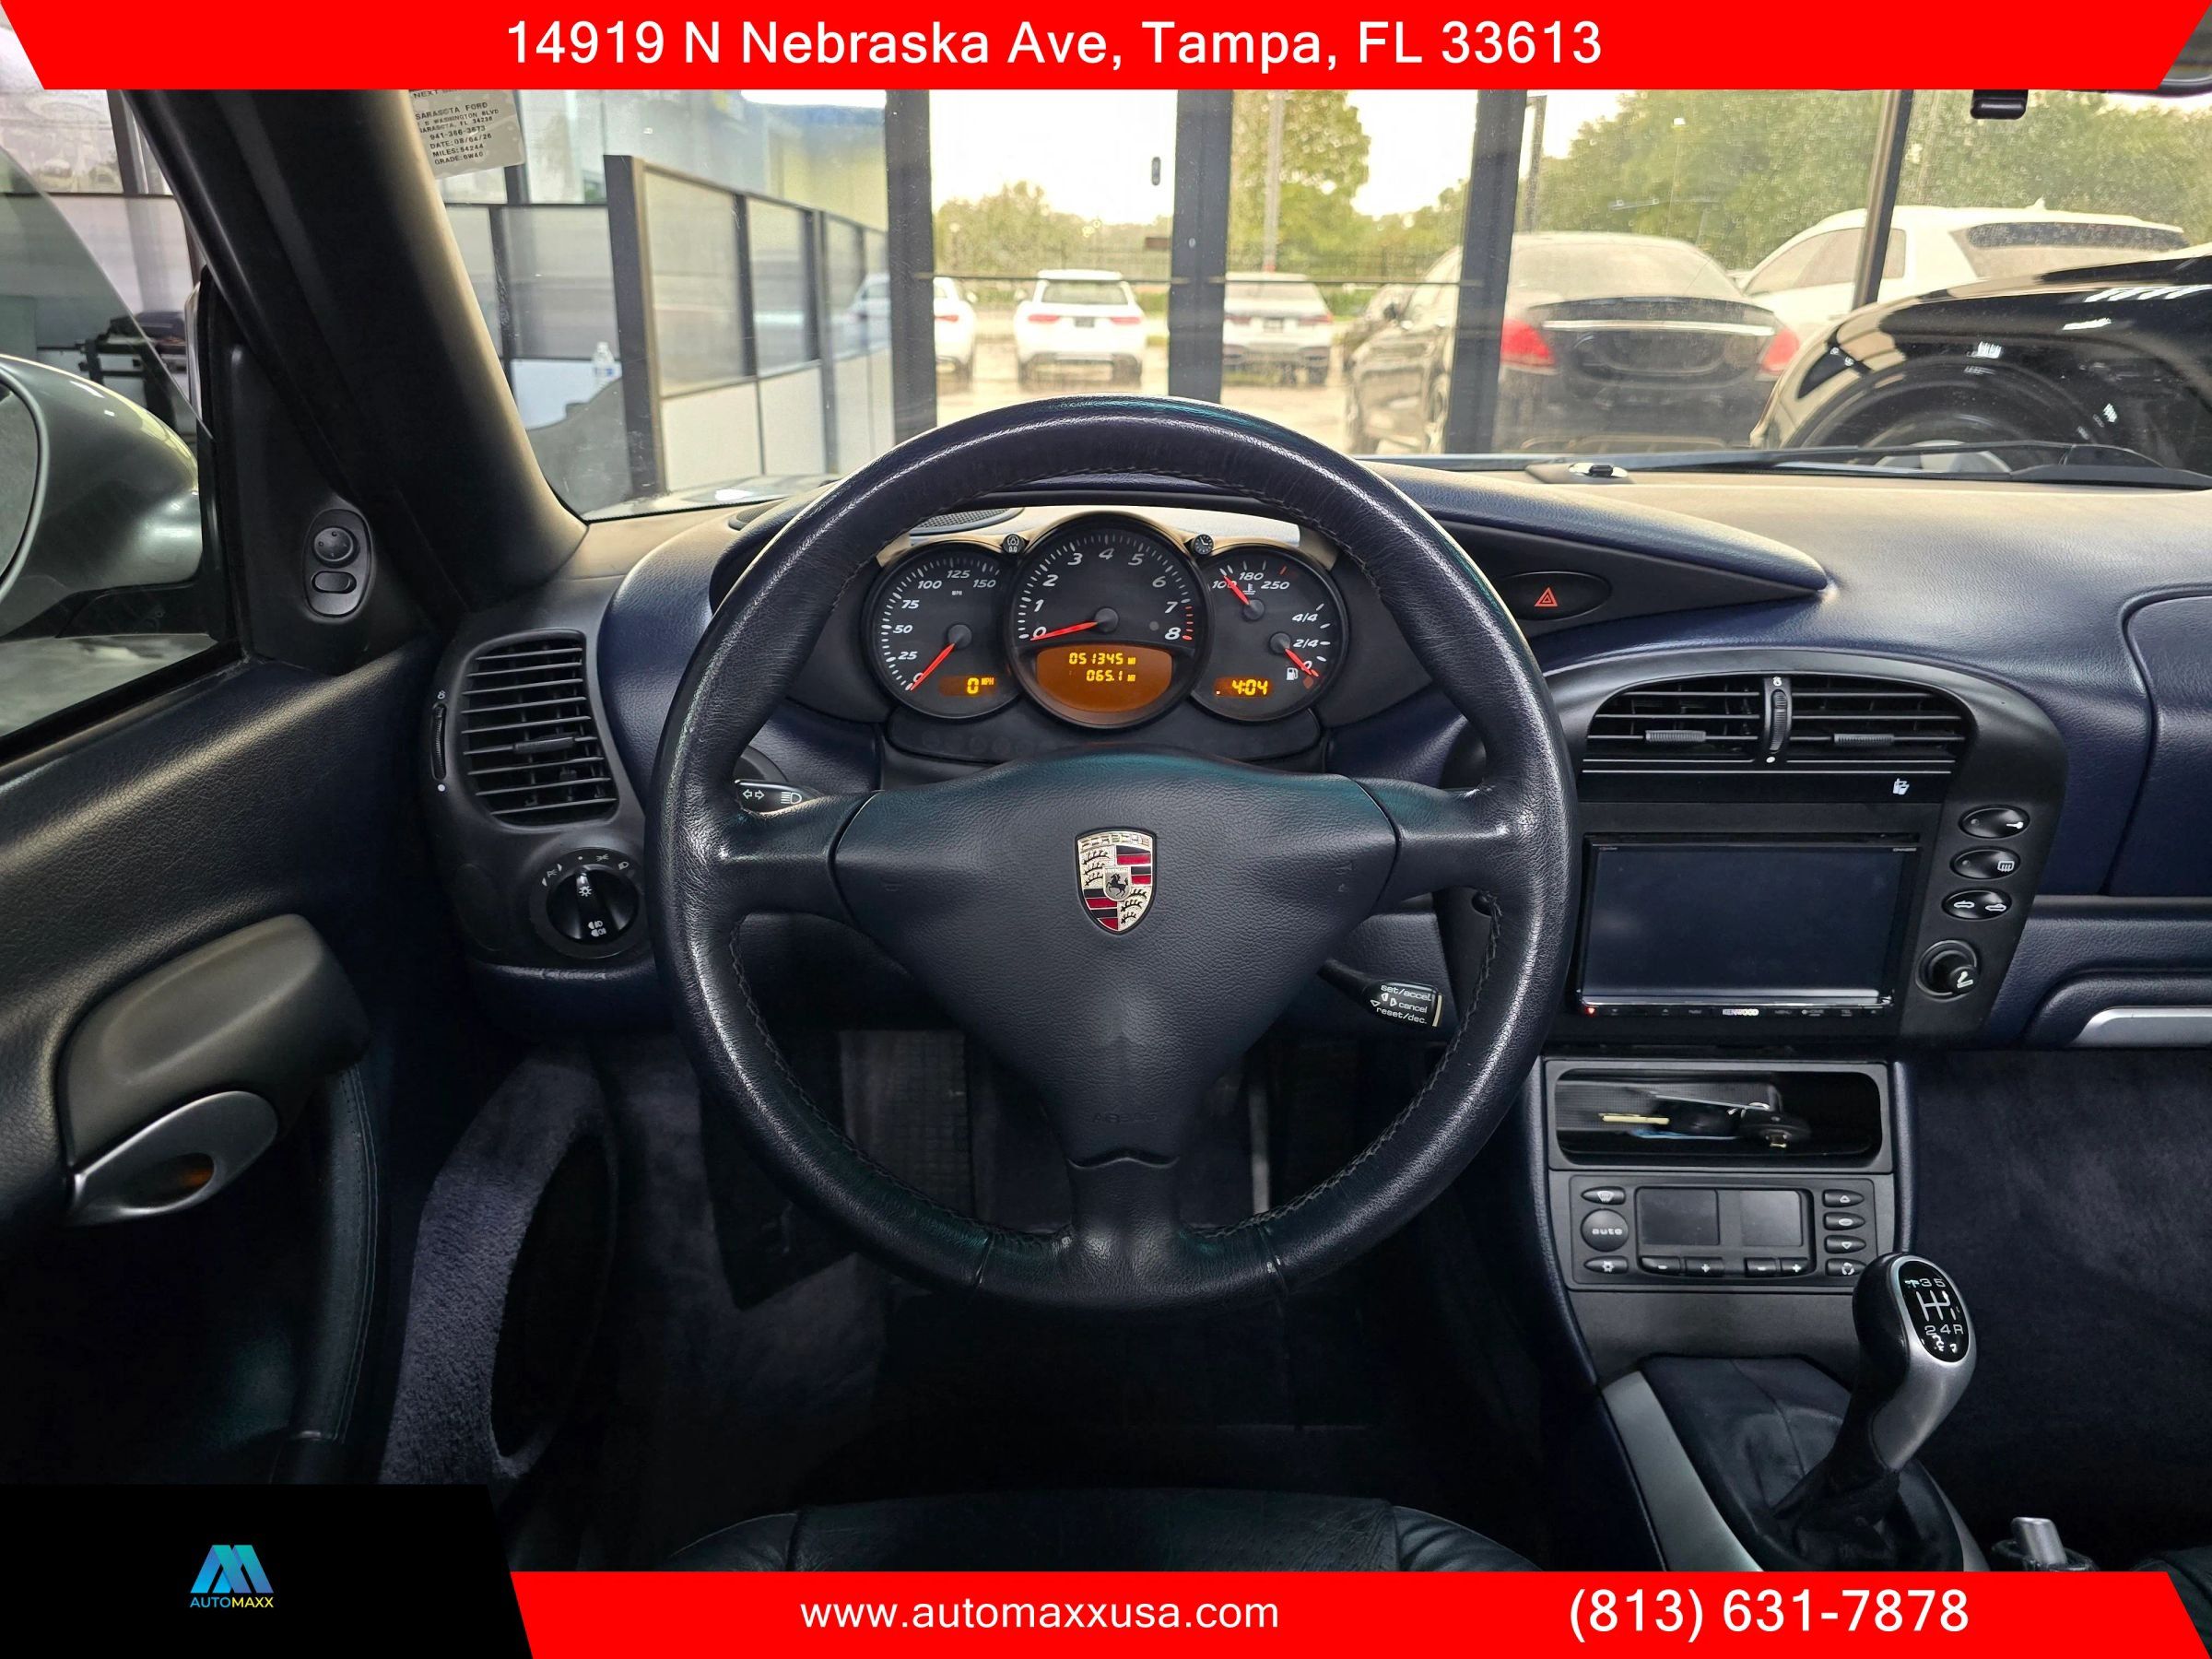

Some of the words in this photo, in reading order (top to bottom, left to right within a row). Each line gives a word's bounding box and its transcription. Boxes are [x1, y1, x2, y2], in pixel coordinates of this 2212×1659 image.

[415, 107, 460, 120] SARASOTA
[465, 101, 488, 111] FORD
[434, 112, 477, 124] WASHINGTON
[1099, 547, 1114, 559] 4
[1067, 553, 1083, 565] 3
[1128, 554, 1145, 565] 5
[947, 570, 971, 579] 125
[1042, 574, 1058, 586] 2
[1240, 571, 1264, 581] 180
[918, 580, 942, 589] 100
[973, 579, 996, 588] 150
[1152, 576, 1166, 587] 6
[1261, 581, 1290, 590] 250
[901, 599, 919, 609] 75
[1034, 599, 1044, 612] 1
[1165, 601, 1178, 613] 7
[1292, 612, 1318, 622] 4/4
[893, 625, 912, 634] 50
[1032, 626, 1047, 639] 0
[1165, 627, 1181, 640] 8
[1293, 638, 1318, 649] 2/4
[899, 651, 918, 660] 25
[1069, 652, 1124, 665] 051345
[1086, 669, 1124, 682] 065.1
[967, 677, 979, 694] 0
[981, 677, 994, 685] MPH
[1232, 678, 1268, 696] 4:04
[1398, 1002, 1428, 1013] cancel
[1376, 1006, 1428, 1024] reset/dec.
[1920, 1278, 1932, 1288] 3
[1934, 1278, 1947, 1288] 5
[1924, 1324, 1936, 1335] 2
[1940, 1324, 1951, 1335] 4
[1953, 1324, 1964, 1335] R
